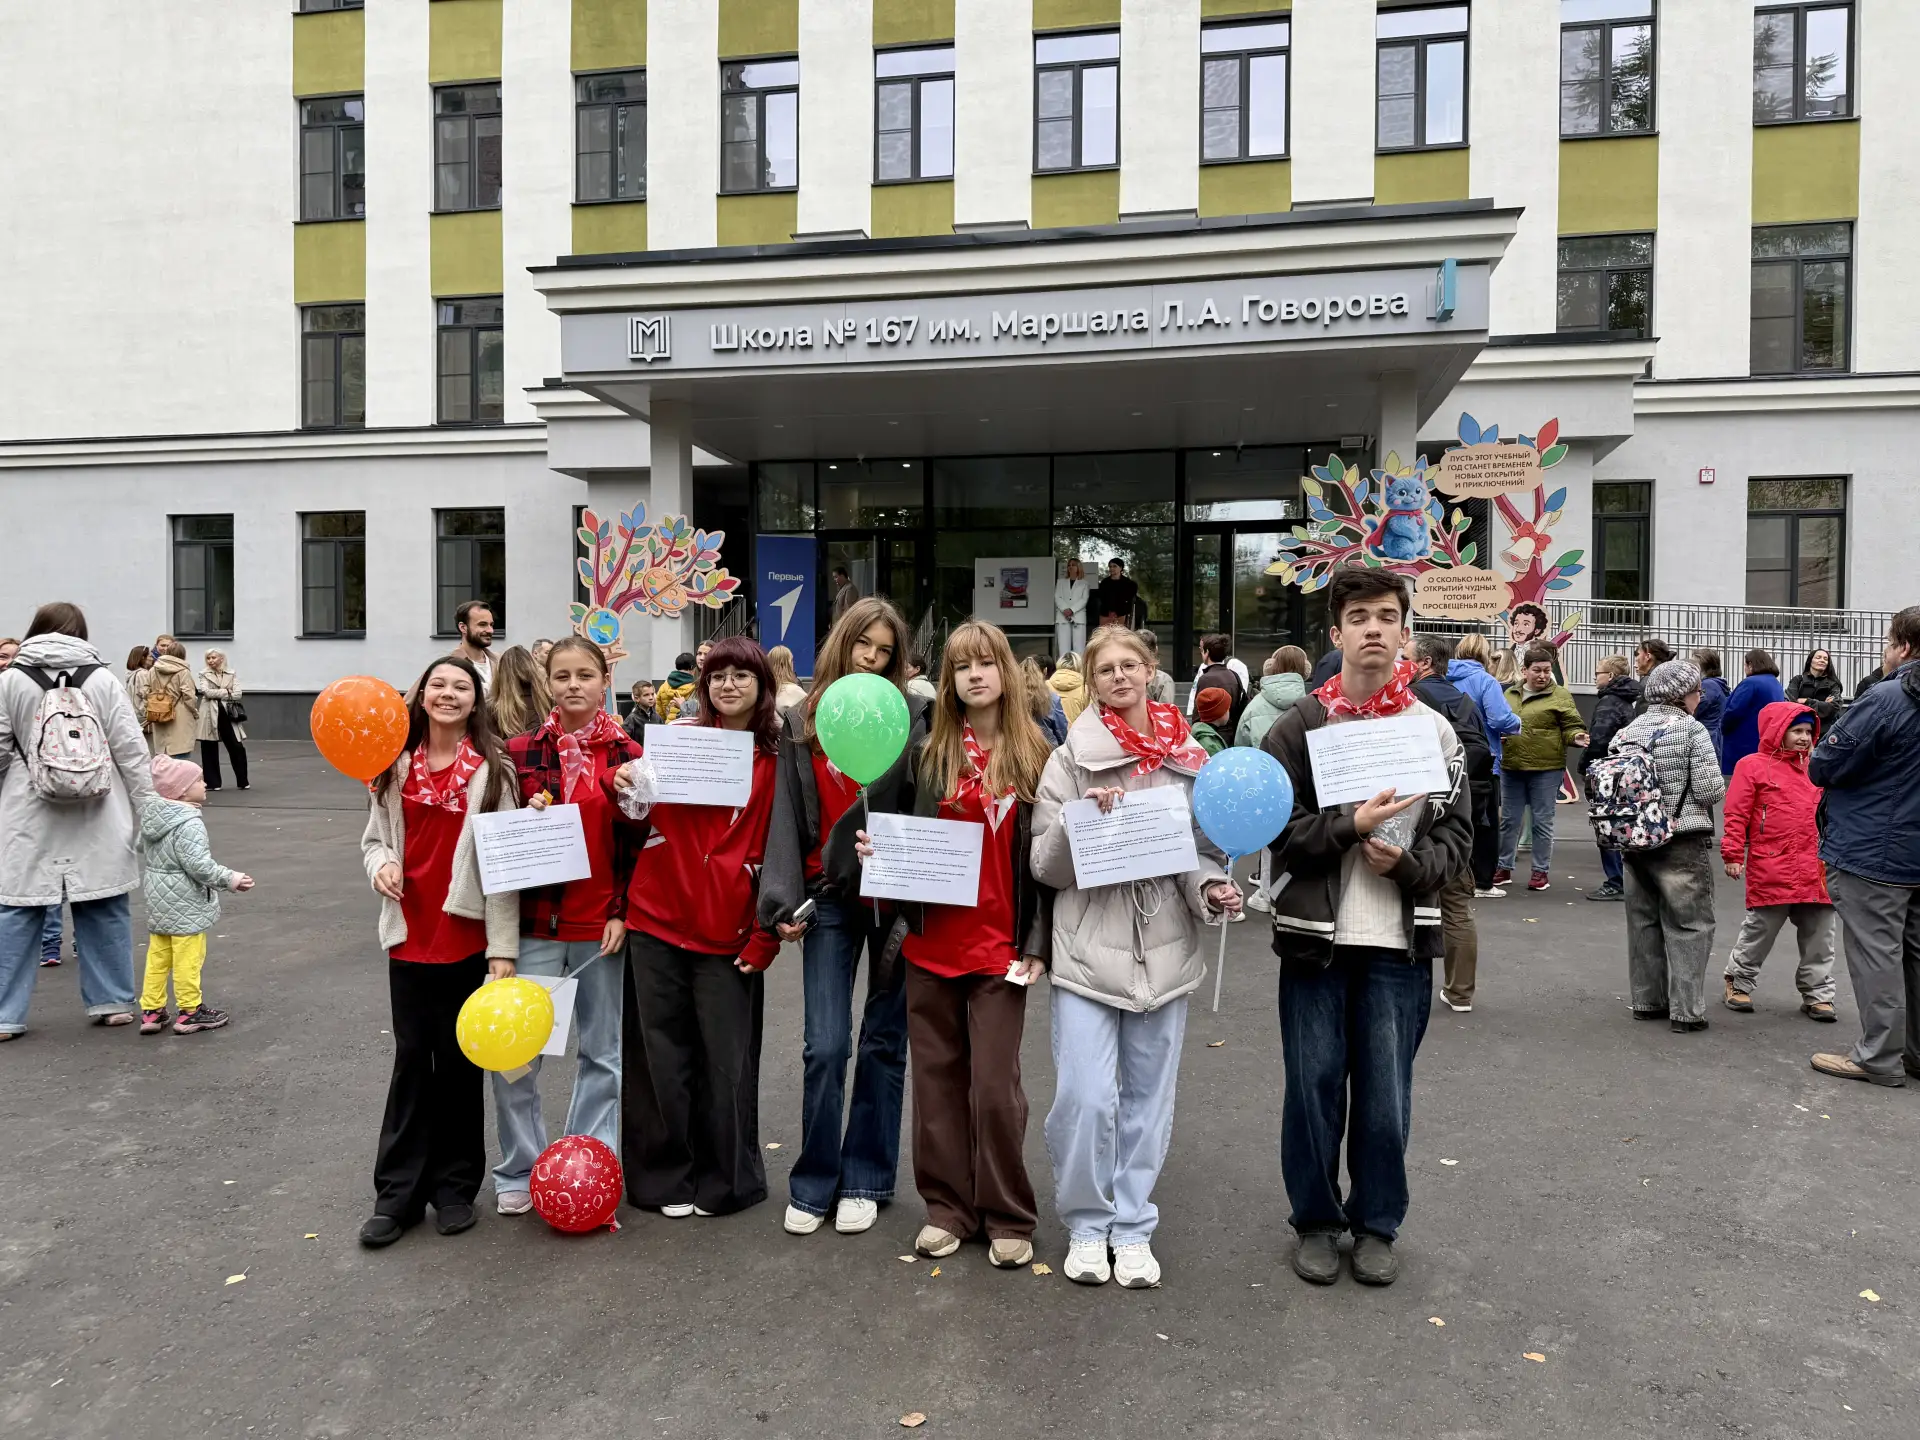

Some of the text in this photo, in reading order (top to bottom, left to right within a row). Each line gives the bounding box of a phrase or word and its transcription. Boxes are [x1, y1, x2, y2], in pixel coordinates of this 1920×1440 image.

[710, 292, 1410, 351] Школа № 167 им. Маршала Л.А. Говорова
[1494, 451, 1531, 460] УЧЕБНЫЙ
[1492, 461, 1533, 469] ВРЕМЕНЕМ
[1454, 469, 1525, 480] НОВЫХ ОТКРЫТИЙ
[1462, 478, 1525, 488] ПРИКЛЮЧЕНИЙ!
[768, 571, 804, 582] Первые
[1423, 584, 1497, 592] ОТКРЫТИЙ ЧУДНЫХ
[1479, 602, 1497, 610] ДУХ!
